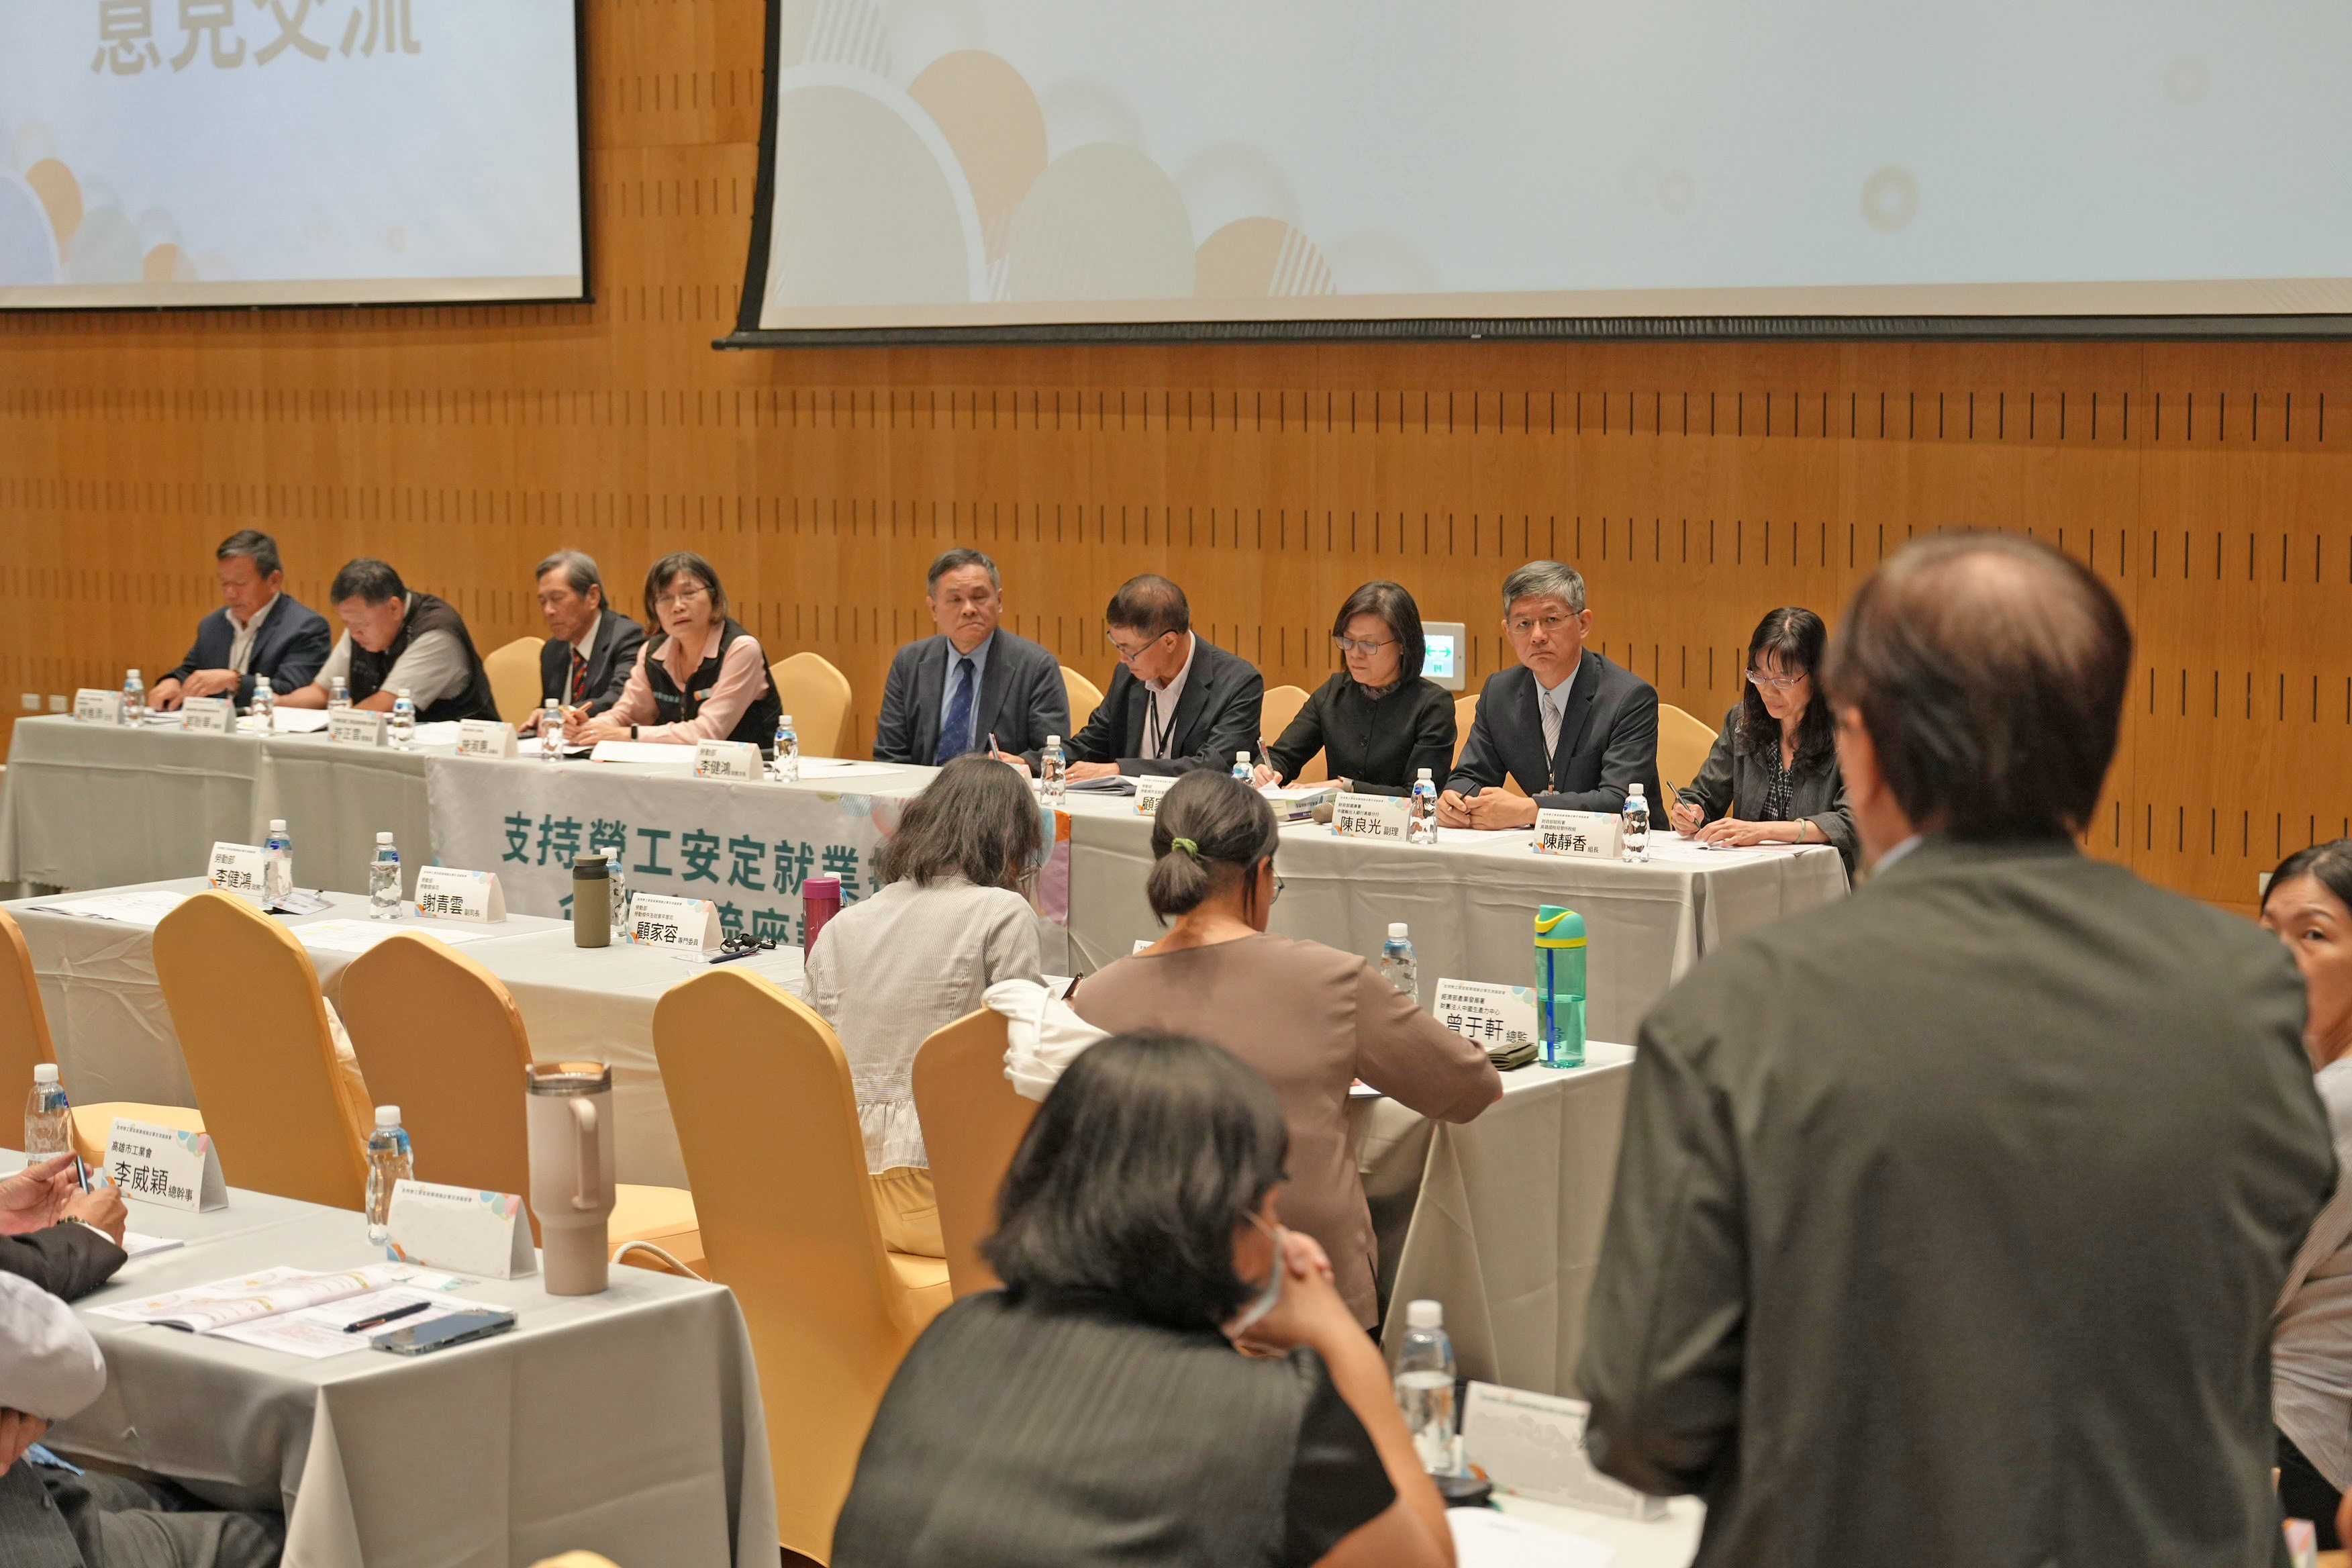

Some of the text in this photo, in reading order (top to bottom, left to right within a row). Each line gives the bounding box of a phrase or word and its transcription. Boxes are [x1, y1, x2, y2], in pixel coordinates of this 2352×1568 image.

[700, 759, 731, 775] 李健鴻
[1340, 816, 1400, 836] 陳良光 副理
[1542, 832, 1587, 852] 陳靜香
[215, 853, 236, 865] 勞動部
[503, 811, 881, 901] 支持勞工安定就業
[215, 868, 252, 890] 李健鴻
[423, 893, 463, 915] 謝青雲
[636, 921, 699, 946] 顧家容 專門委員
[1440, 993, 1485, 1005] 經濟部產業發展署
[1440, 1002, 1501, 1016] 財團法人中國生產力中心
[1447, 1013, 1528, 1044] 曾于軒 總監
[111, 1140, 152, 1159] 高雄市工業會
[168, 1184, 193, 1202] 總幹事
